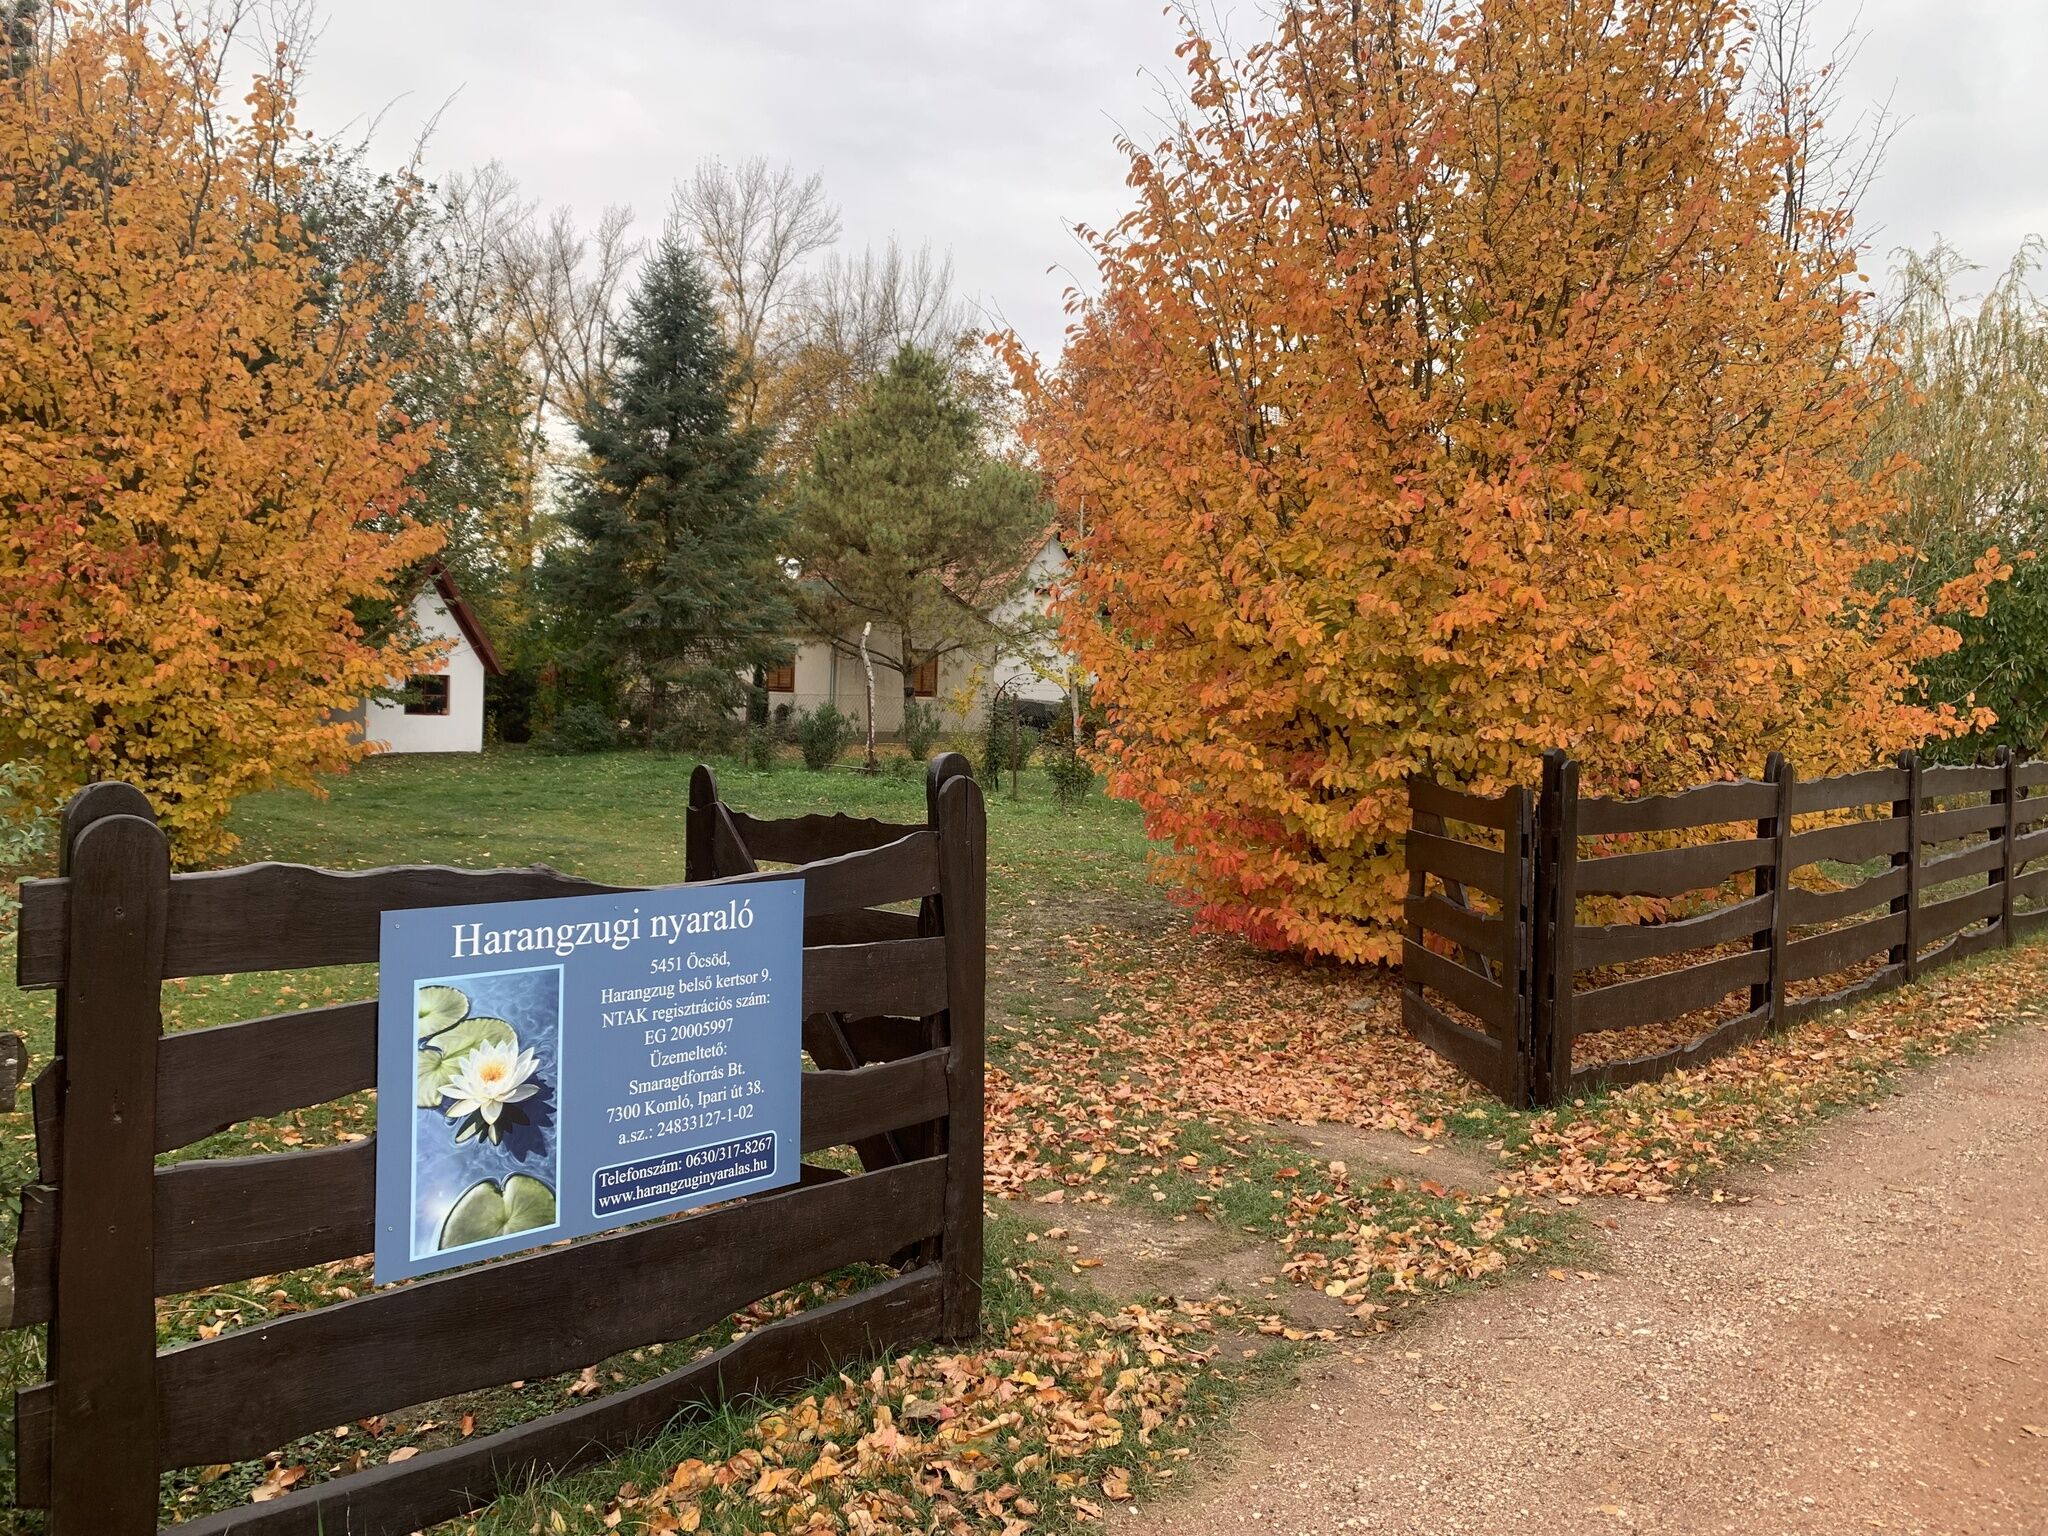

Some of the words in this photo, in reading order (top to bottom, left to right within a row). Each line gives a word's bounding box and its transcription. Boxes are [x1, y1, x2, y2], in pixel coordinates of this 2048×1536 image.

[451, 907, 640, 957] Harangzugi
[650, 898, 754, 944] nyaraló
[650, 957, 682, 974] 5451
[687, 951, 731, 970] Öcsöd,
[601, 984, 675, 1004] Harangzug
[679, 976, 712, 994] belső
[716, 972, 759, 989] kertsor
[761, 968, 772, 983] 9.
[602, 1008, 648, 1028] NTAK
[652, 996, 733, 1022] regisztrációs
[736, 993, 771, 1009] szám:
[644, 1029, 667, 1045] EG
[670, 1018, 734, 1041] 20005997
[650, 1042, 728, 1068] Üzemeltető:
[629, 1067, 724, 1095] Smaragdforrás
[728, 1062, 746, 1076] Bt.
[607, 1103, 641, 1124] 7300
[645, 1094, 694, 1117] Komló,
[698, 1086, 727, 1108] Ipari
[731, 1085, 743, 1099] út
[746, 1080, 765, 1096] 38.
[618, 1128, 653, 1145] a.sz.:
[657, 1104, 754, 1137] 24833127-1-02
[599, 1159, 682, 1188] Telefonszám:
[685, 1137, 773, 1168] 0630/317-8267
[599, 1158, 768, 1208] www.harangzuginyaralas.hu
